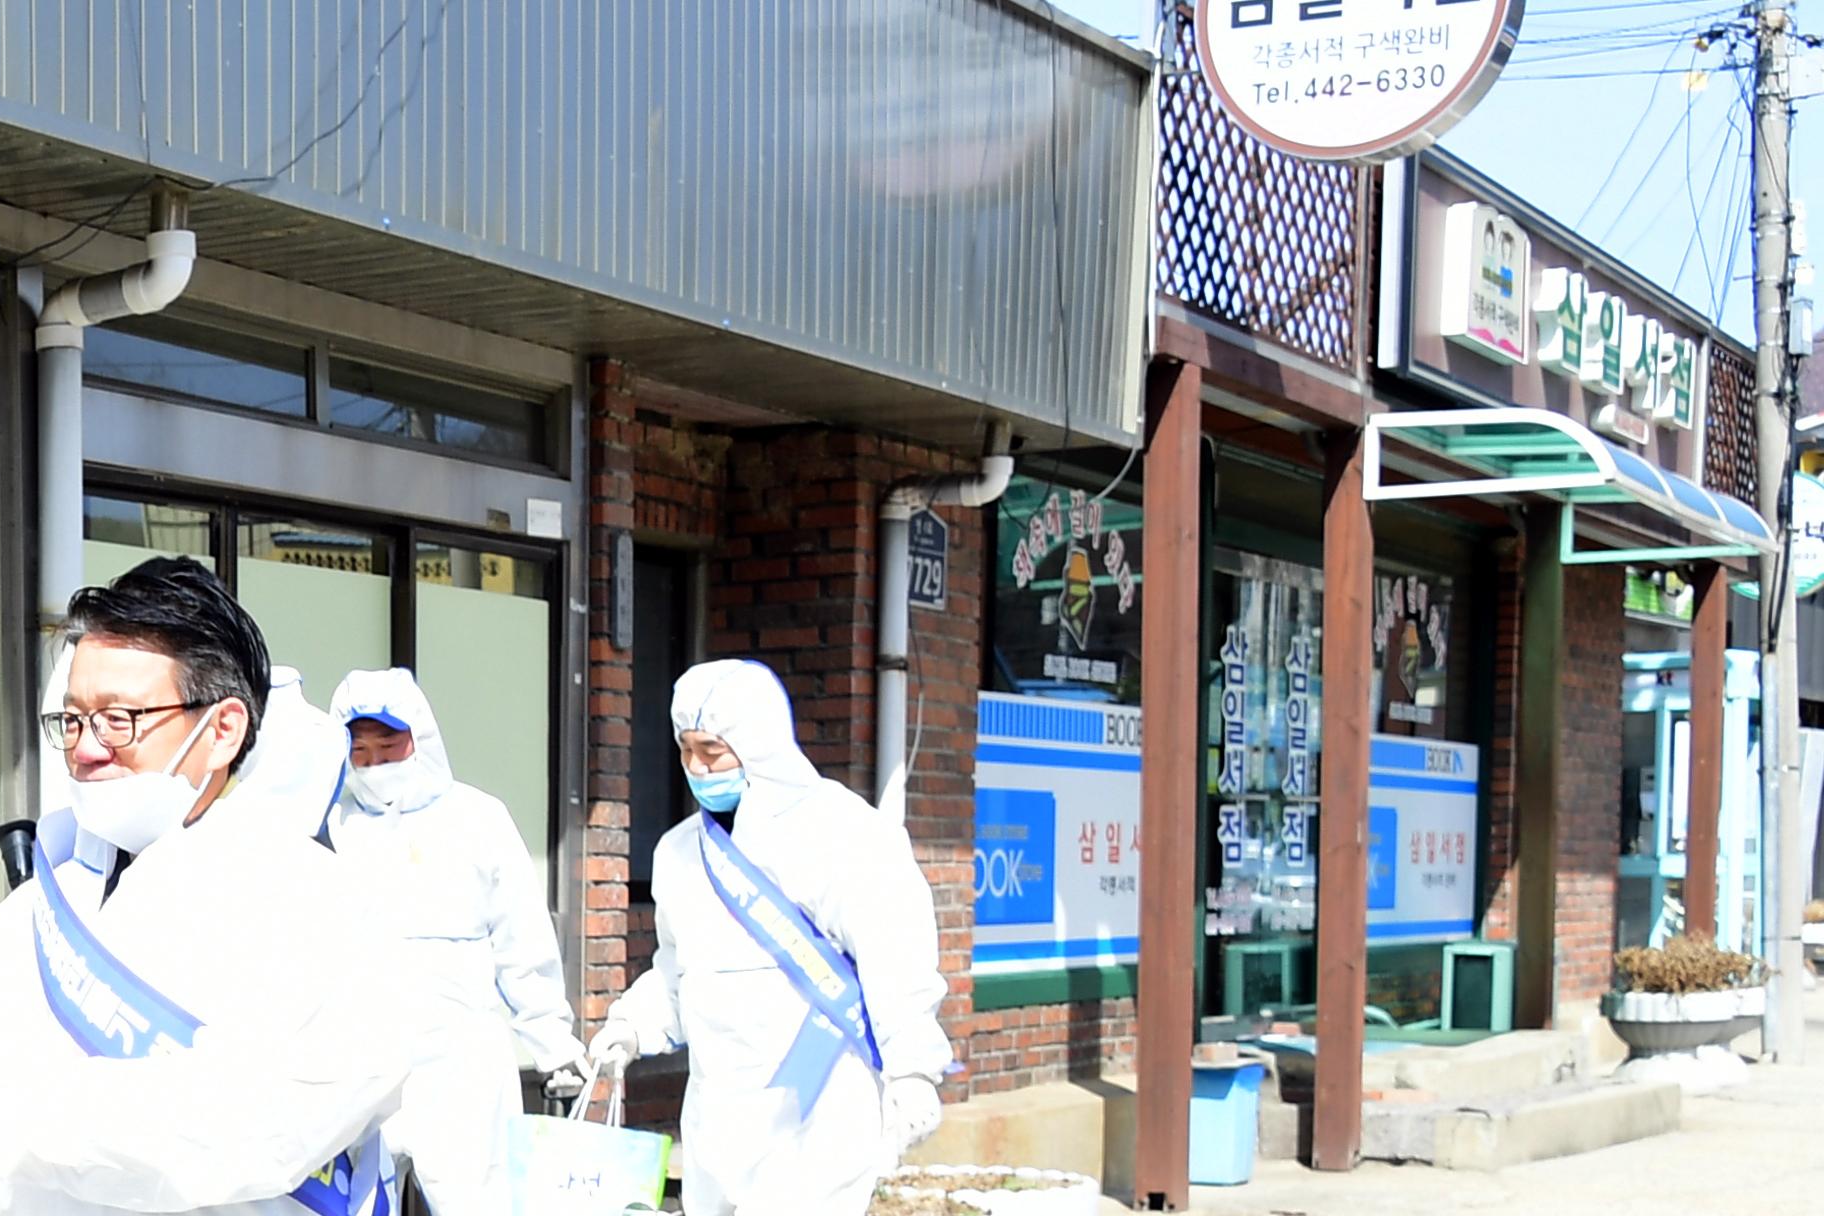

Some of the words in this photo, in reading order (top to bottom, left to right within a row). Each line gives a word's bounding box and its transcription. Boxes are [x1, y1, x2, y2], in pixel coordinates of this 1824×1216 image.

[1252, 35, 1345, 69] 각종서적
[1353, 24, 1451, 60] 구색완비
[1252, 63, 1447, 105] Tel.442-6330
[1557, 272, 1694, 426] 삼일서점
[1218, 626, 1249, 867] 삼일서점
[1280, 634, 1312, 866] 삼일서점
